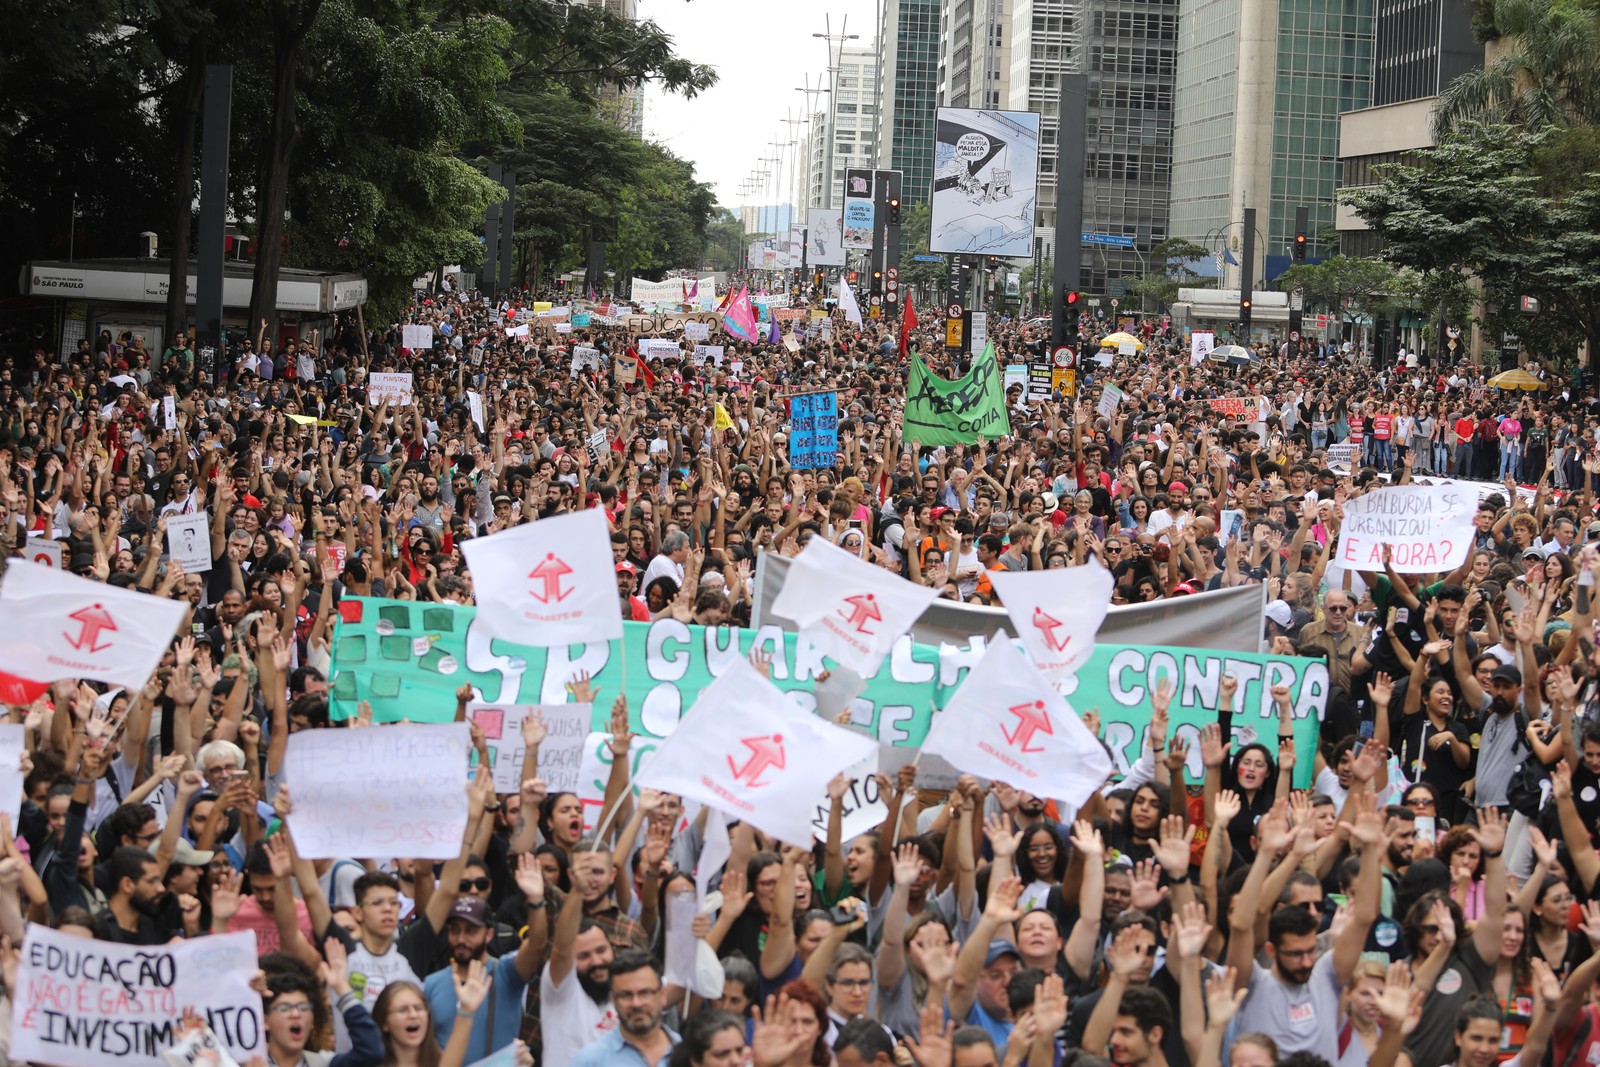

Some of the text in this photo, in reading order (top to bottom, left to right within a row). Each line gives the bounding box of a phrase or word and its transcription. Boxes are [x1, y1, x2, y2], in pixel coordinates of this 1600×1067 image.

[951, 254, 960, 275] Min.
[41, 279, 84, 289] SÃO PAULO
[146, 288, 158, 296] Sua
[383, 375, 408, 383] MINISTRO
[801, 395, 831, 413] PELO
[1210, 399, 1242, 408] DEFESA
[1244, 398, 1255, 407] DA
[792, 415, 836, 432] DIREITO
[957, 407, 1001, 433] COTIA
[1236, 414, 1246, 422] DO
[1366, 493, 1432, 514] BALBÚRDIA
[1440, 493, 1460, 513] SE
[1348, 514, 1431, 537] ORGANIZOU!
[1344, 537, 1360, 561] E
[1108, 648, 1330, 722] CONTRA
[31, 943, 177, 999] EDUCAÇÃO
[28, 976, 71, 1011] NÃO
[76, 979, 93, 1013] É
